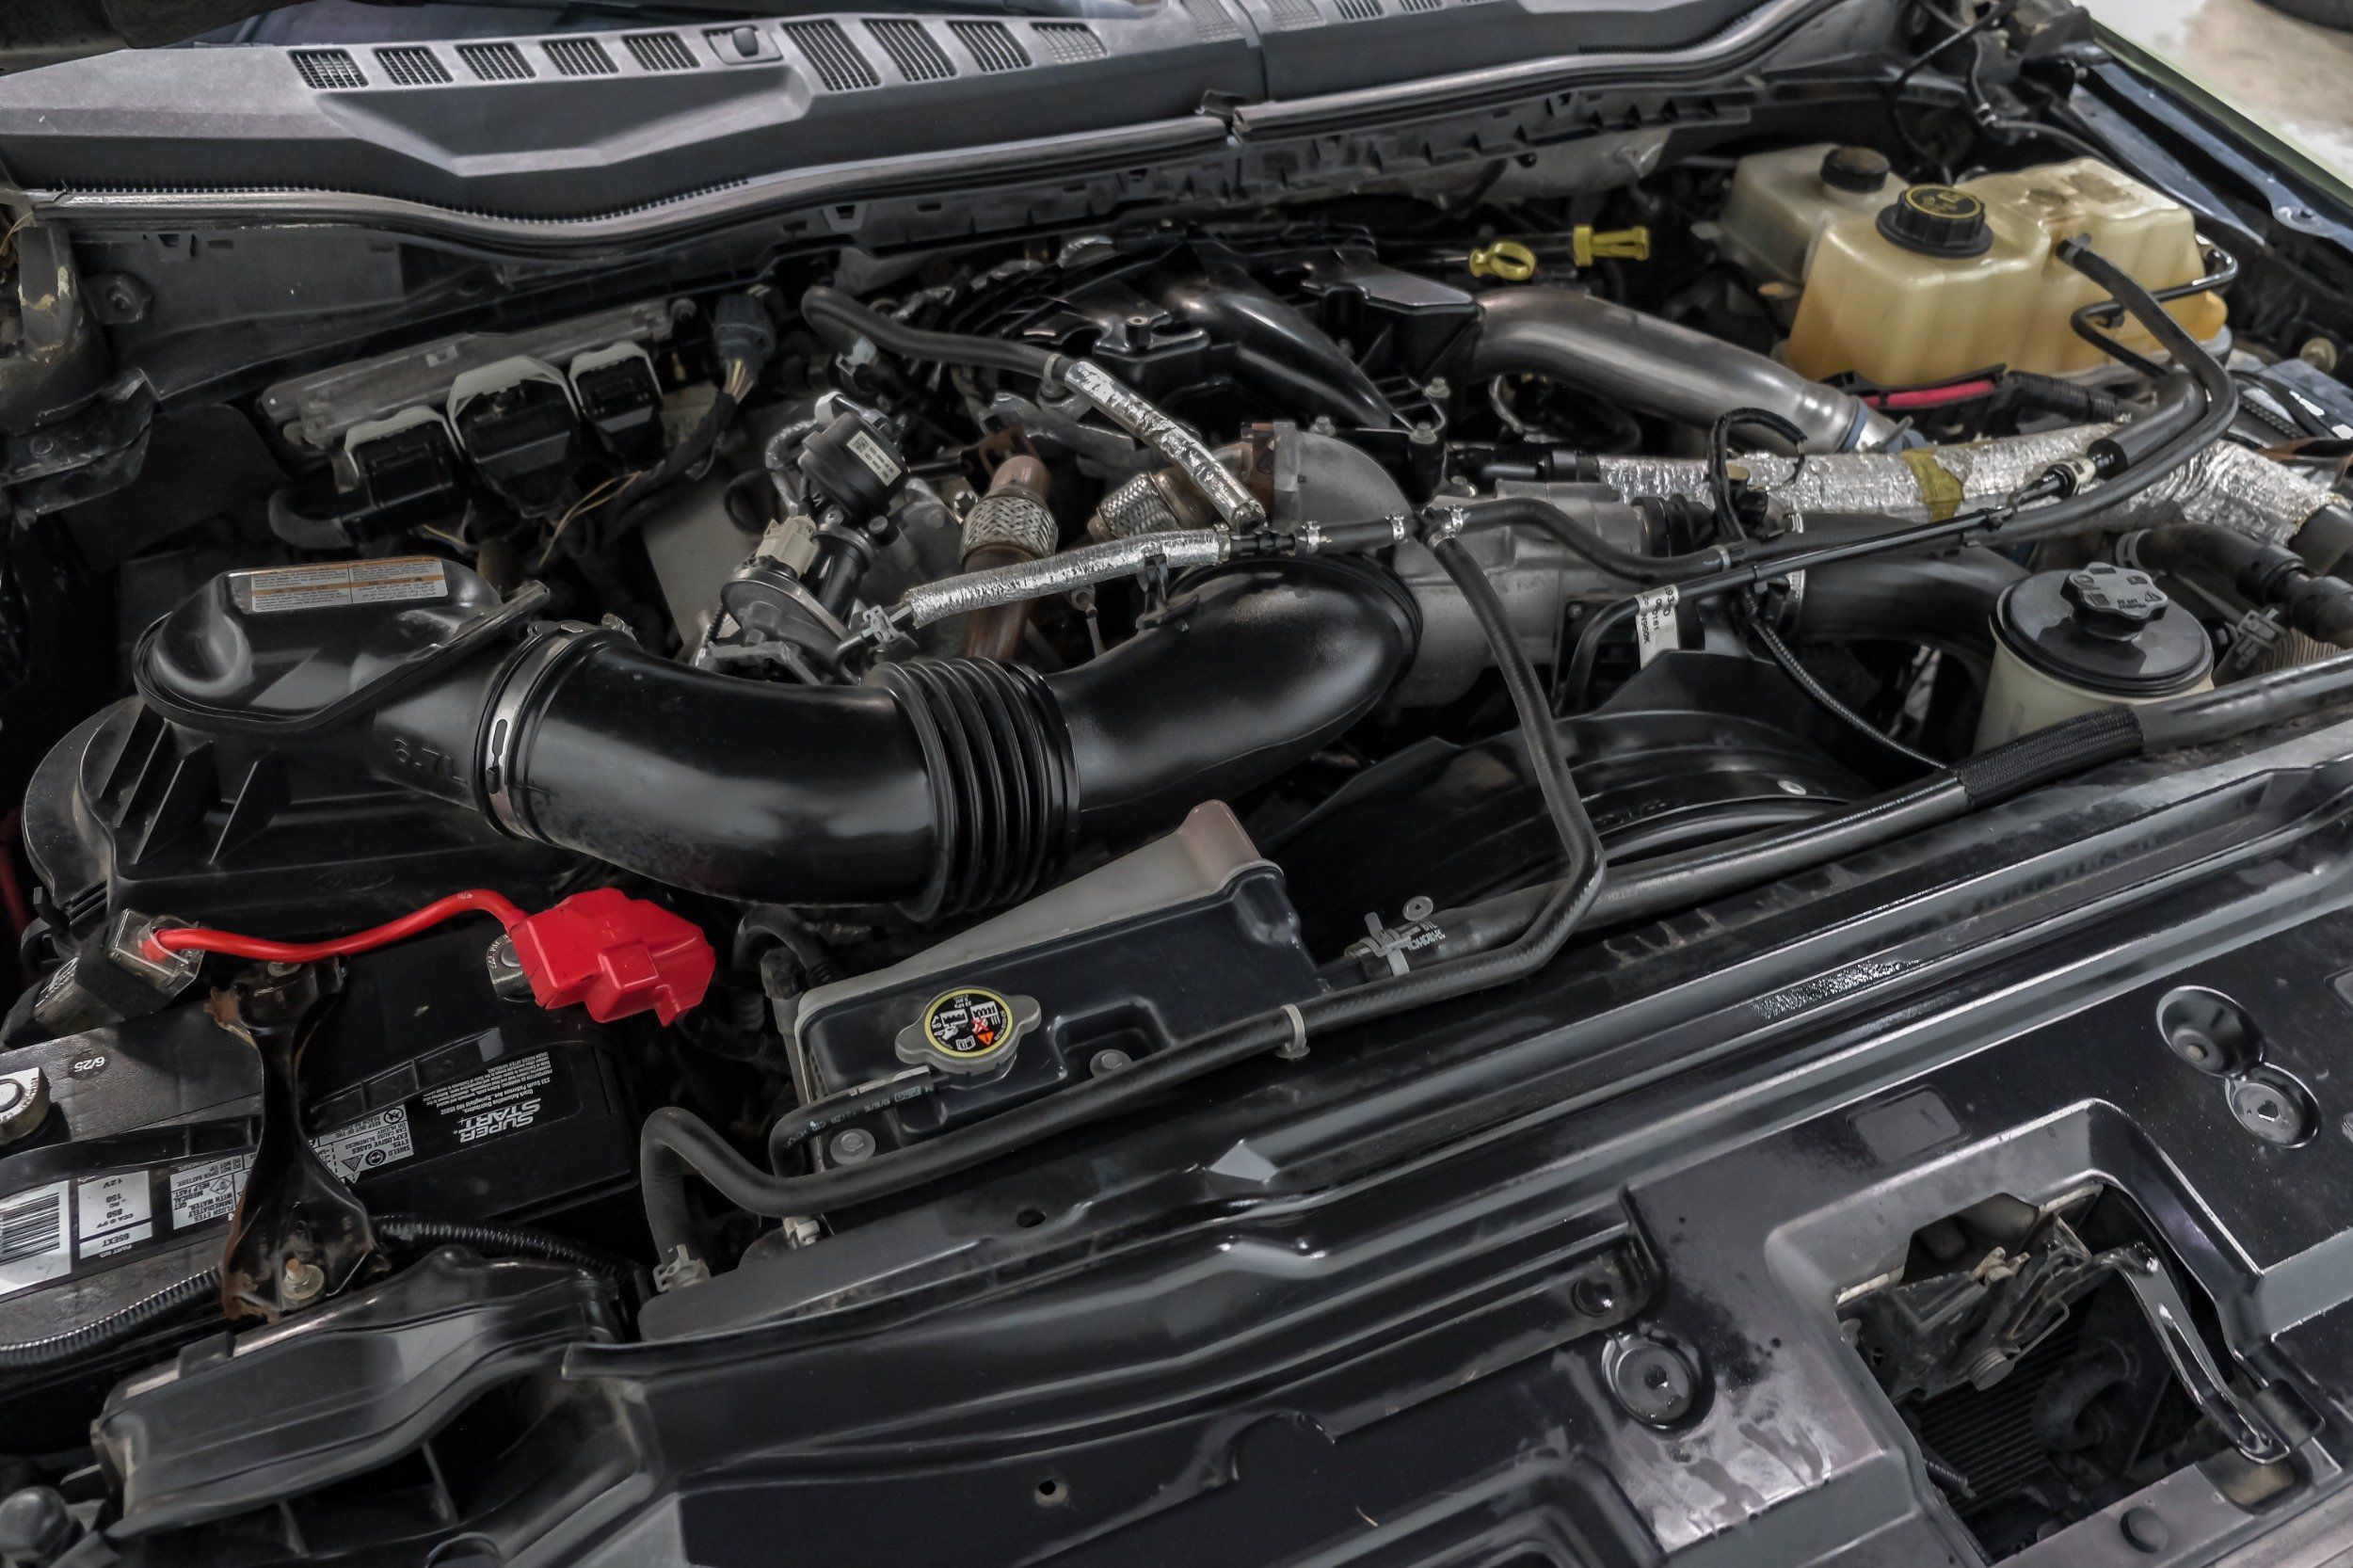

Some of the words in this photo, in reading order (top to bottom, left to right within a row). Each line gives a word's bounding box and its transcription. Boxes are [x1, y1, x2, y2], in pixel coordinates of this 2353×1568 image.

[73, 1057, 105, 1072] 6/25
[458, 1098, 540, 1133] START
[460, 1112, 533, 1143] SUPER
[374, 1133, 408, 1147] EXPLOSIVE
[376, 1131, 393, 1140] CAUSE
[345, 1136, 375, 1149] BLINDNESS
[352, 1144, 372, 1154] GASES
[388, 1145, 410, 1157] SHIELD
[103, 1178, 123, 1189] 12V
[193, 1183, 210, 1192] HELP
[173, 1191, 203, 1203] MEDICAL
[215, 1192, 232, 1202] WITH
[173, 1202, 187, 1210] GET
[188, 1199, 233, 1218] IMMEDIATELY
[214, 1206, 234, 1216] FLUSH
[119, 1213, 134, 1222] CCA
[194, 1212, 212, 1222] EYES
[112, 1244, 132, 1255] PART
